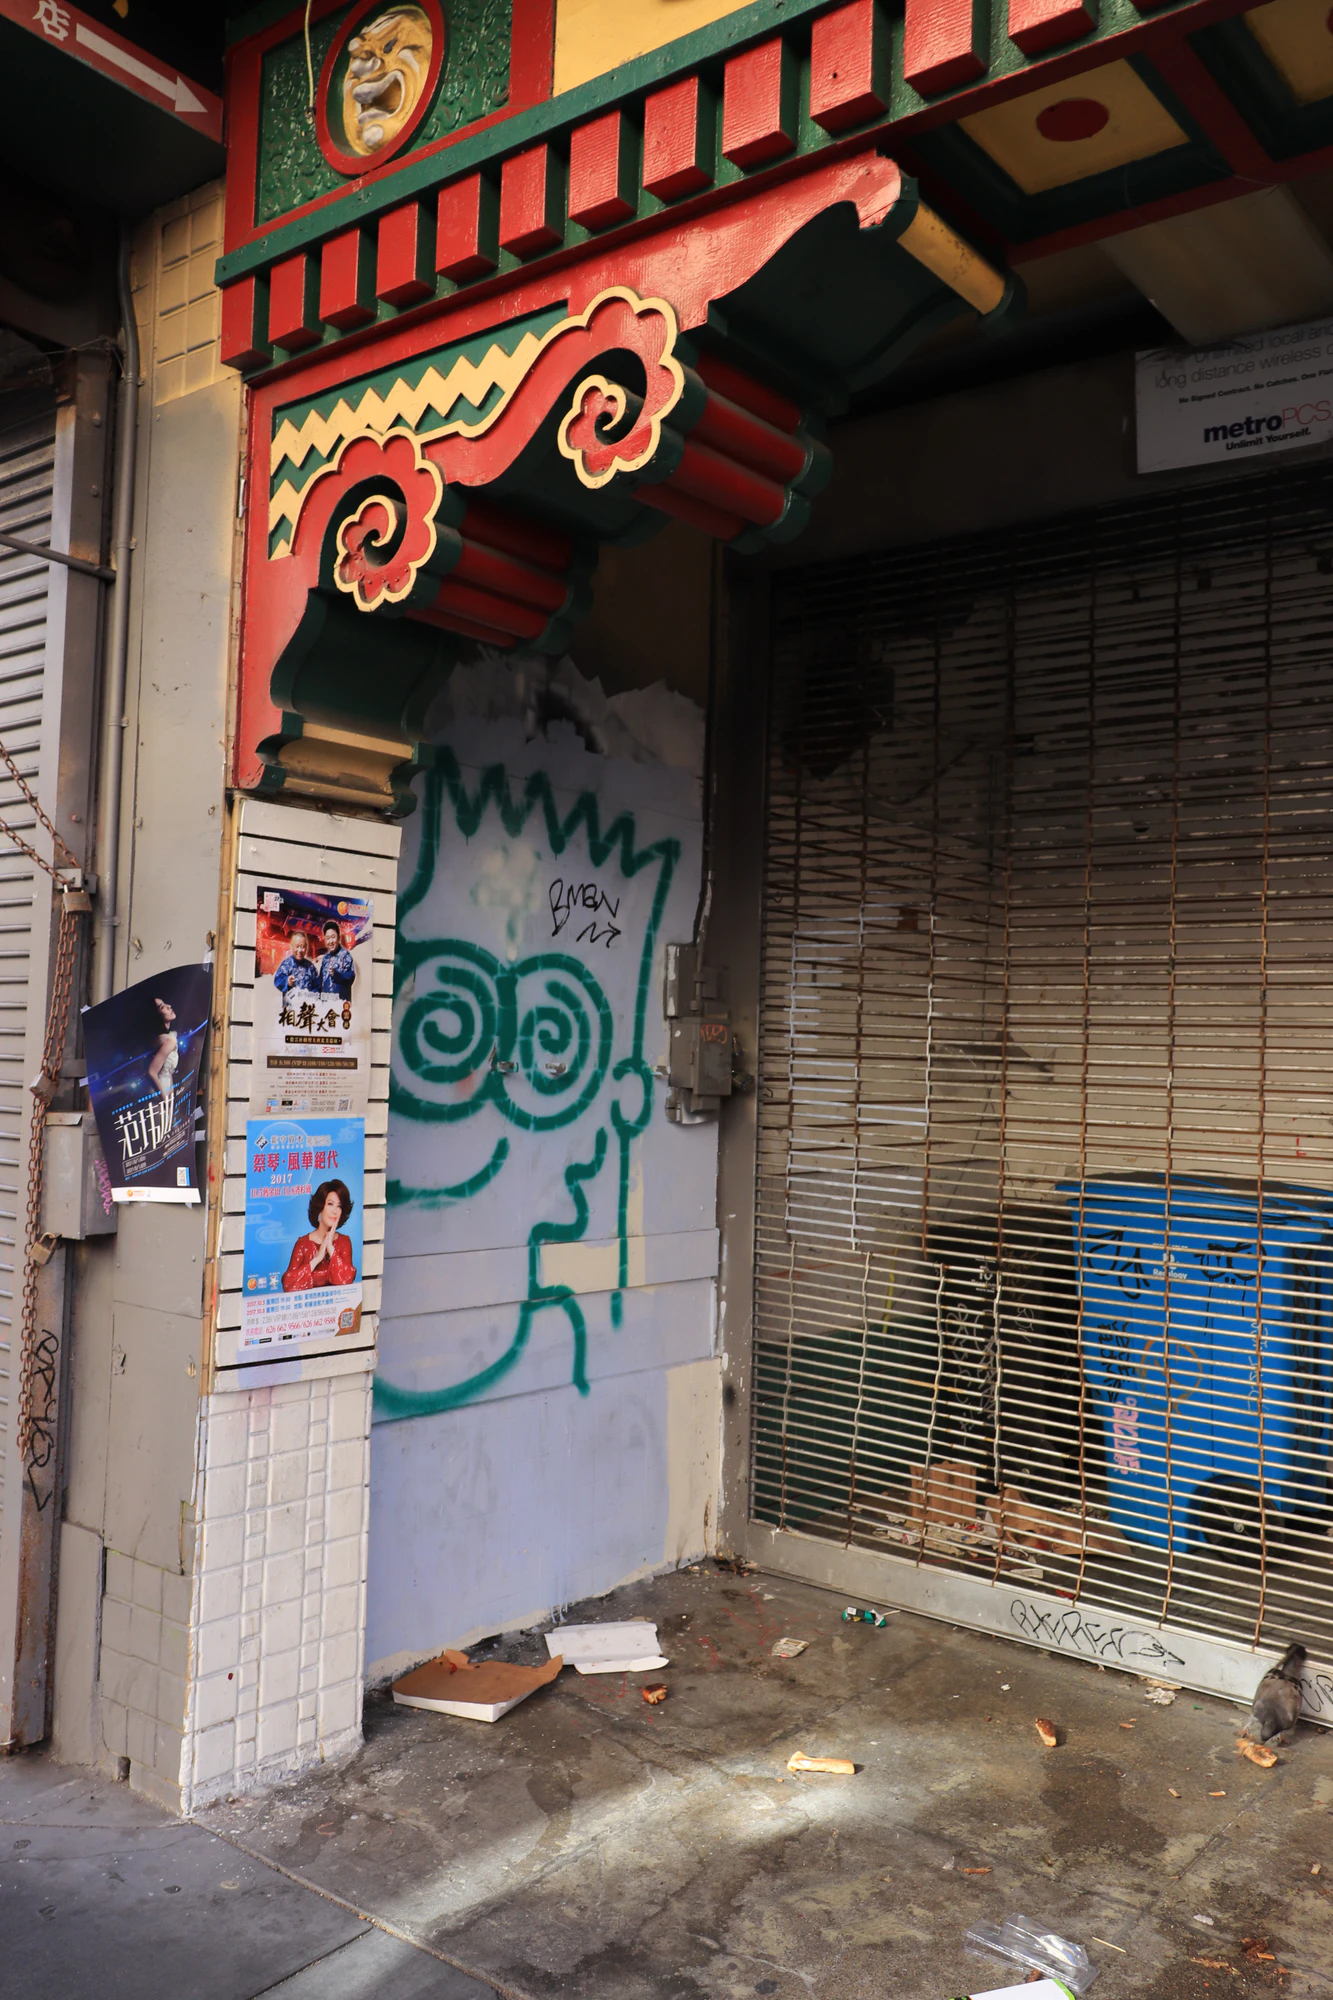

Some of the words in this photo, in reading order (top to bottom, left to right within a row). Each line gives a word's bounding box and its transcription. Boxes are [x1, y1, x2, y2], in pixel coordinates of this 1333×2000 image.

[32, 0, 71, 41] 店
[1268, 328, 1304, 348] local
[1155, 373, 1187, 389] long
[1191, 360, 1255, 383] distance
[1259, 346, 1321, 369] wireless
[1191, 391, 1216, 402] Signed
[1218, 385, 1252, 397] Contract.
[1254, 383, 1264, 391] No
[1266, 376, 1299, 388] Catches.
[1301, 372, 1316, 381] One
[1226, 436, 1264, 451] Unlimit
[1266, 427, 1312, 444] Yourself.
[270, 1173, 293, 1184] 2017
[265, 1325, 277, 1335] 626
[277, 1323, 287, 1332] 662
[313, 1319, 323, 1327] 662
